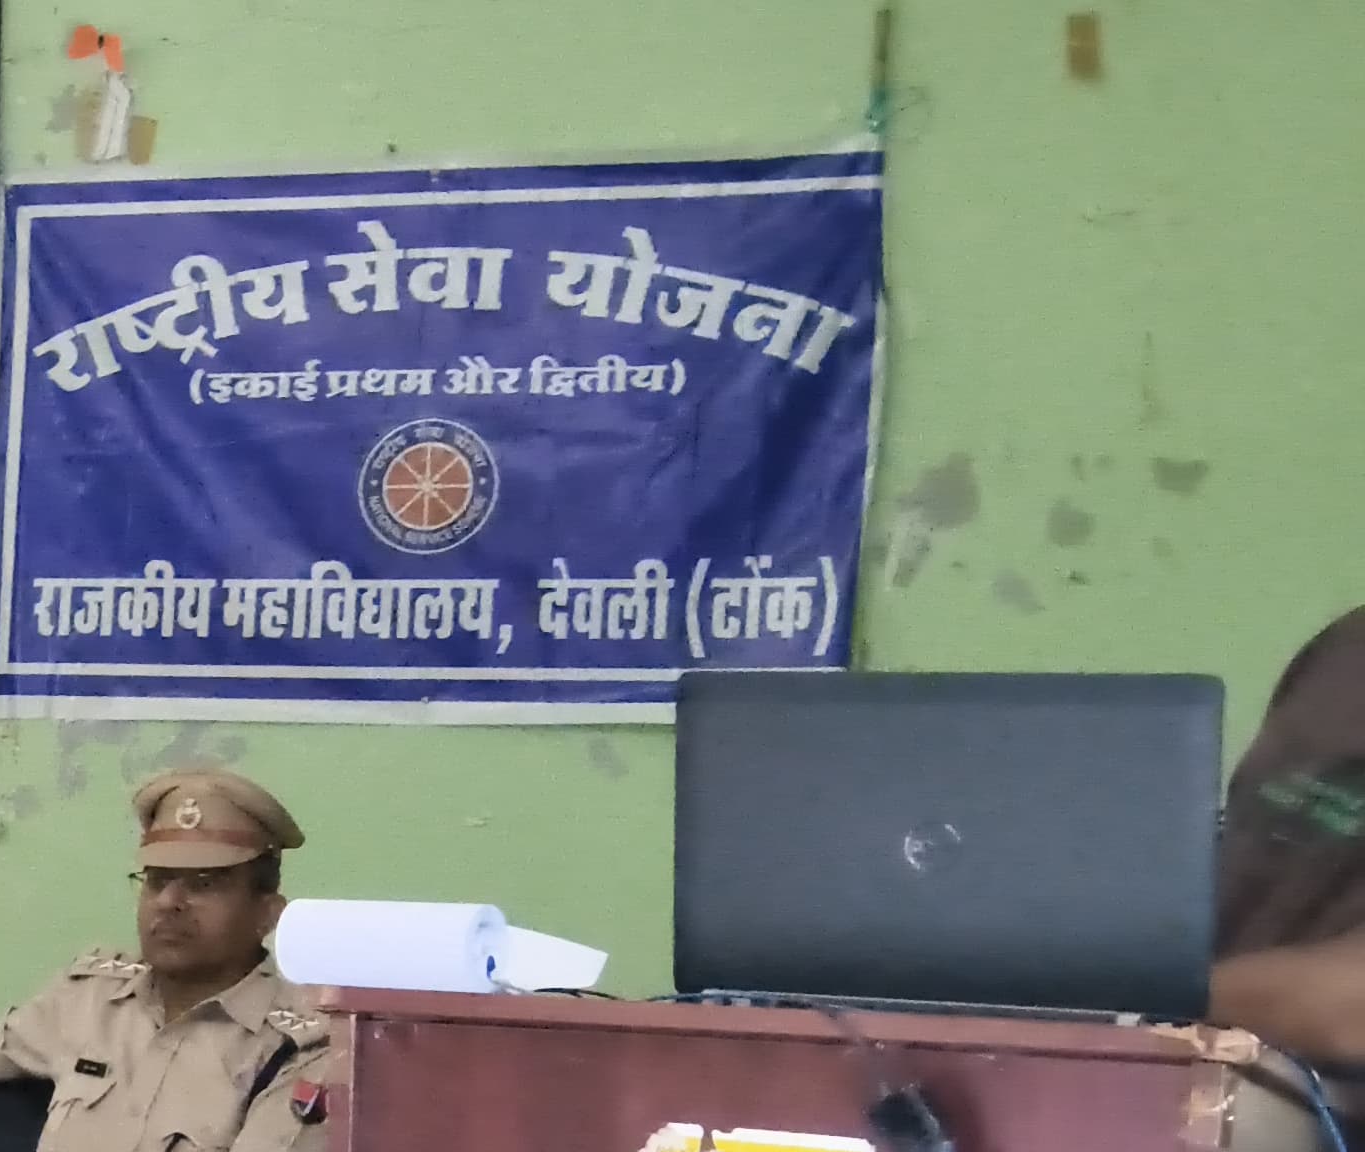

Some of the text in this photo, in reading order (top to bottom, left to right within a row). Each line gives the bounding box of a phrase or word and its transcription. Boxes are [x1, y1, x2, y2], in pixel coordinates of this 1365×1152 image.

[32, 221, 862, 393] राष्ट्रीय सेवा योजना
[188, 354, 687, 405] (इकाई प्रथम और द्वितीय)
[33, 556, 838, 658] राजकीय महाविद्यालय, देवली (टोंक)
